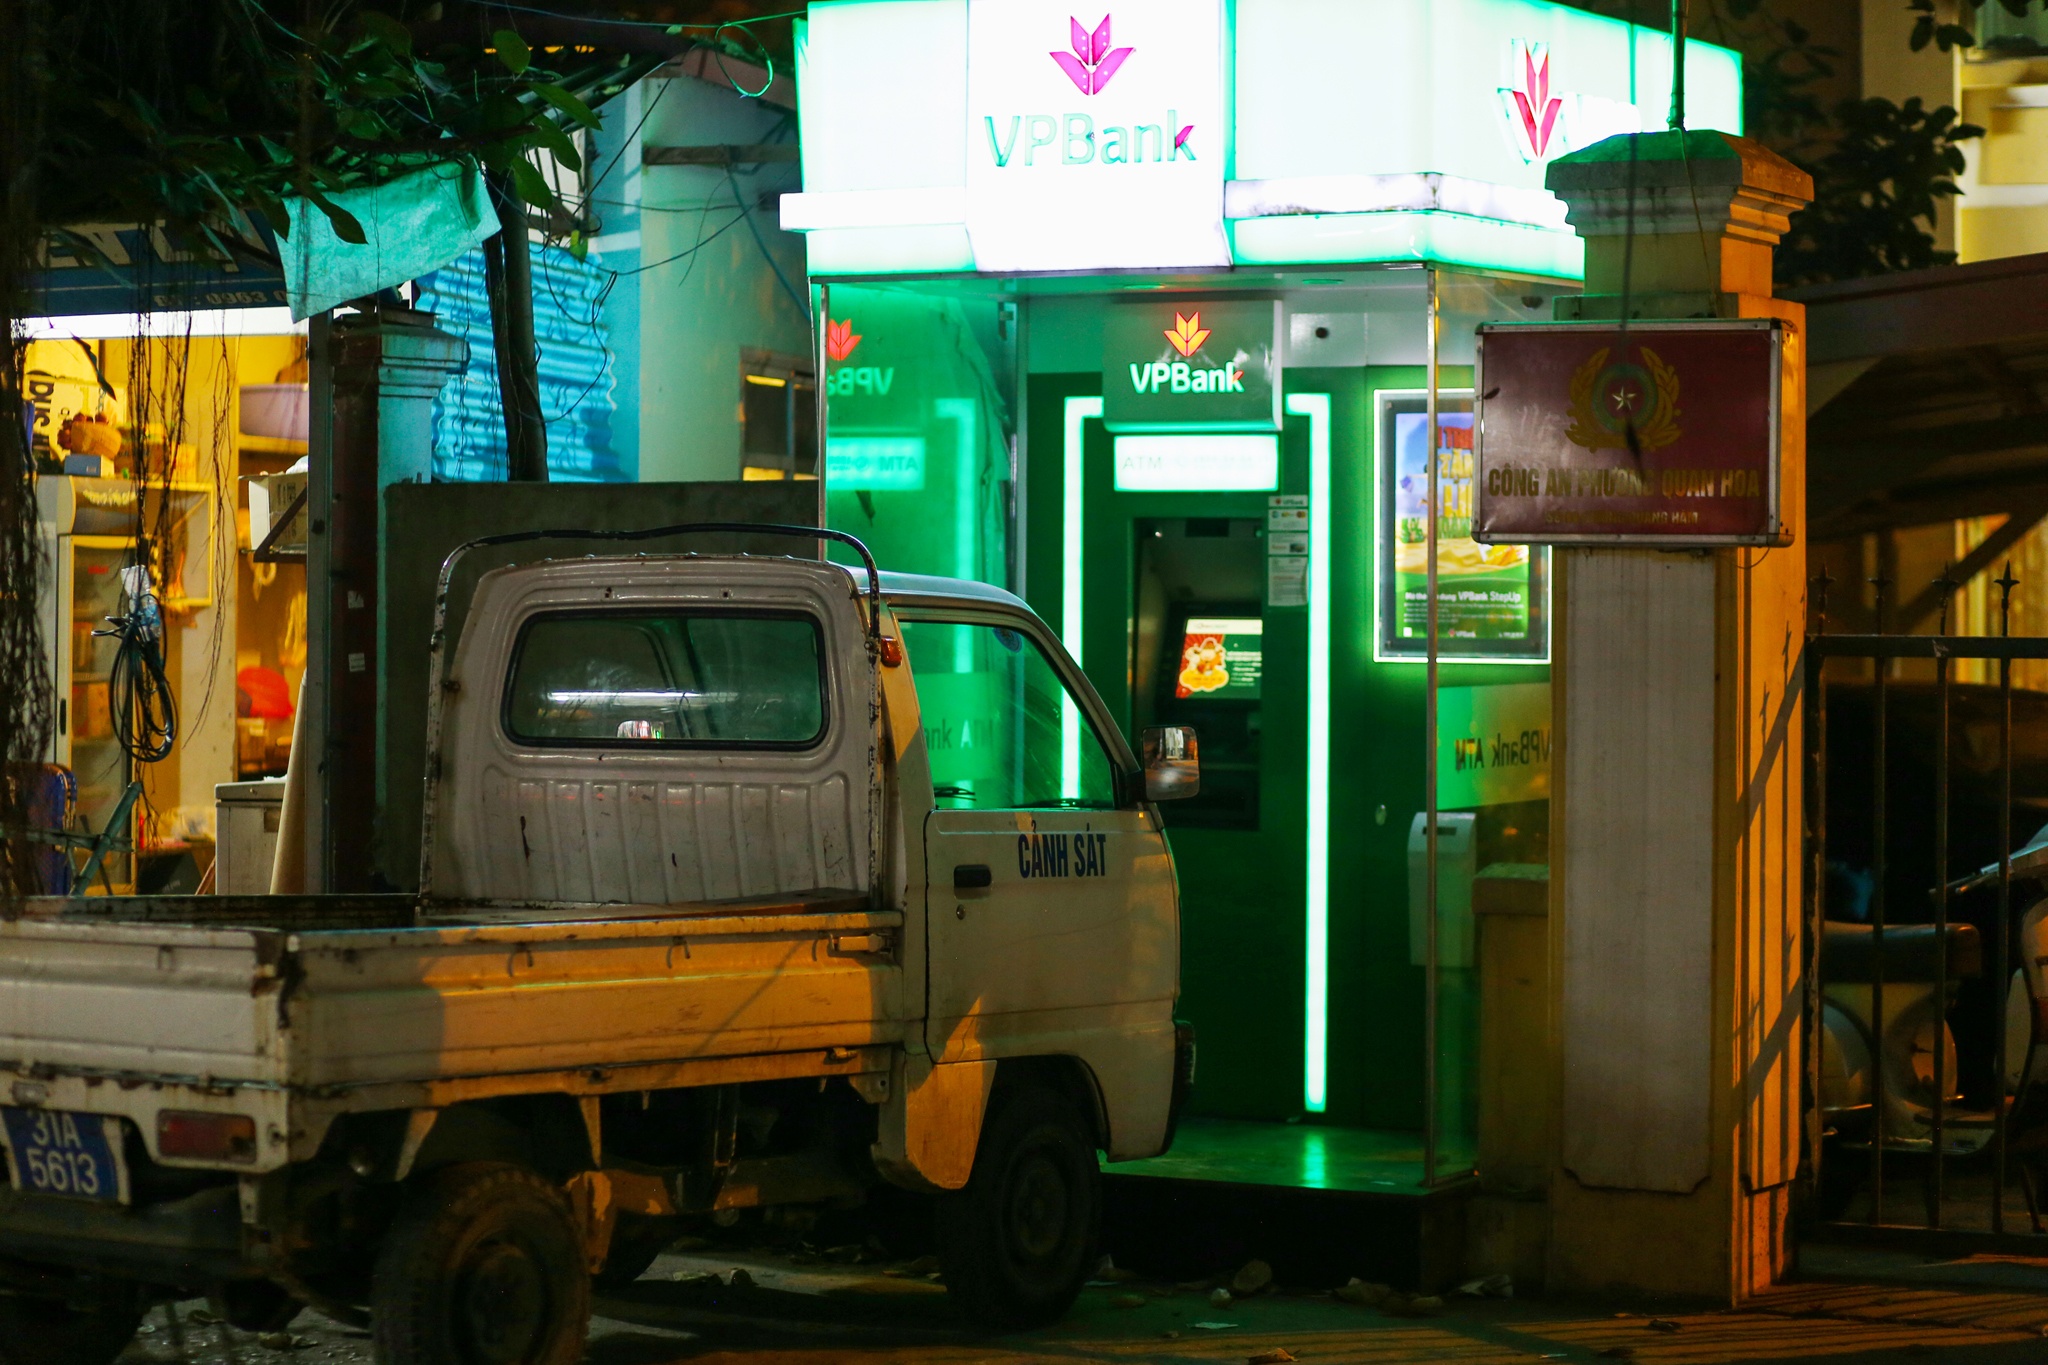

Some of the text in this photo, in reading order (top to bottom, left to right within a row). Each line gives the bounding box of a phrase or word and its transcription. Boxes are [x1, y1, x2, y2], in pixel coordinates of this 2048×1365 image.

[984, 109, 1197, 167] VPBank
[1129, 361, 1245, 393] VPBank
[1122, 456, 1163, 470] ATM
[1488, 463, 1540, 497] CÔNG
[1545, 468, 1573, 497] AN
[1662, 468, 1714, 500] QUAN
[1720, 468, 1760, 497] HOA
[1458, 591, 1488, 602] VPBank
[1017, 820, 1106, 878] CẢNH SÁT
[27, 1109, 82, 1149] 31A
[26, 1147, 100, 1195] 5613
